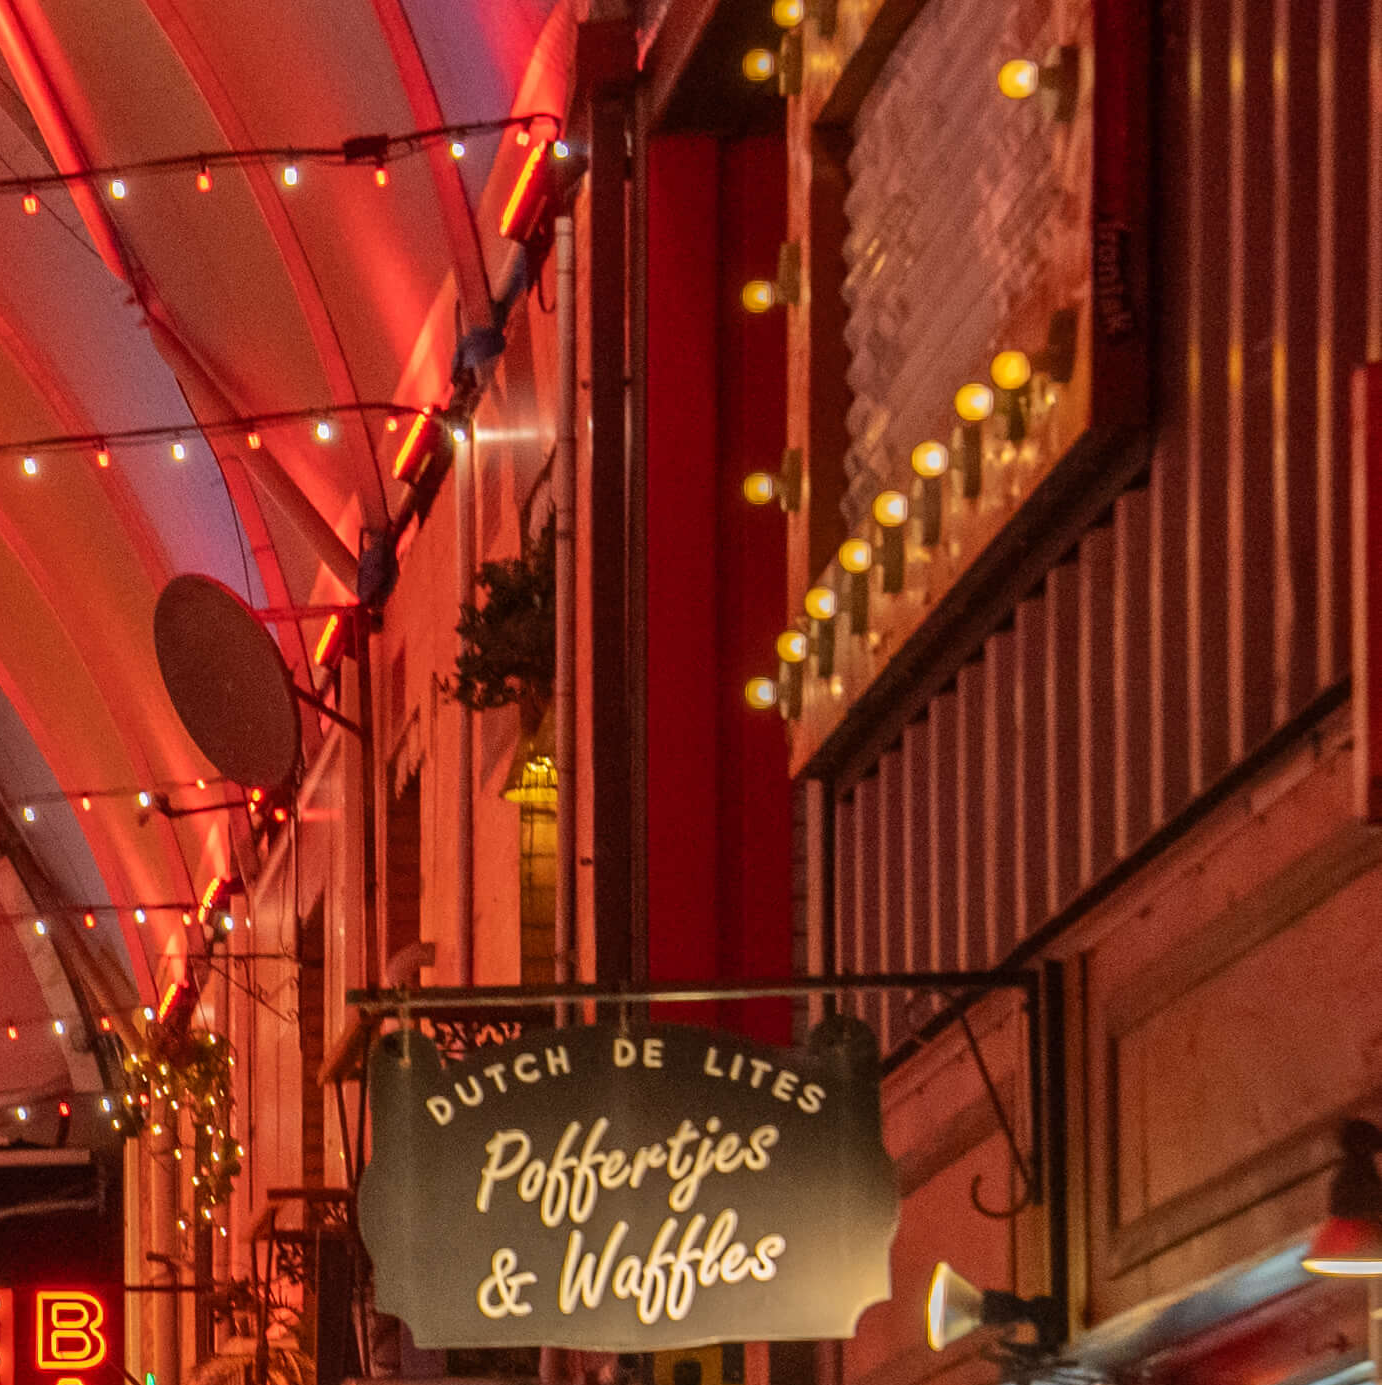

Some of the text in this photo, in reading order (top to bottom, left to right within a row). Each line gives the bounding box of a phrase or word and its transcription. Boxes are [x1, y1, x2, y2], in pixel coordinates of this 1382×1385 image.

[425, 1037, 827, 1127] DUTCH DE LITES
[476, 1116, 780, 1228] Poffertjes
[477, 1208, 787, 1325] & Waffles
